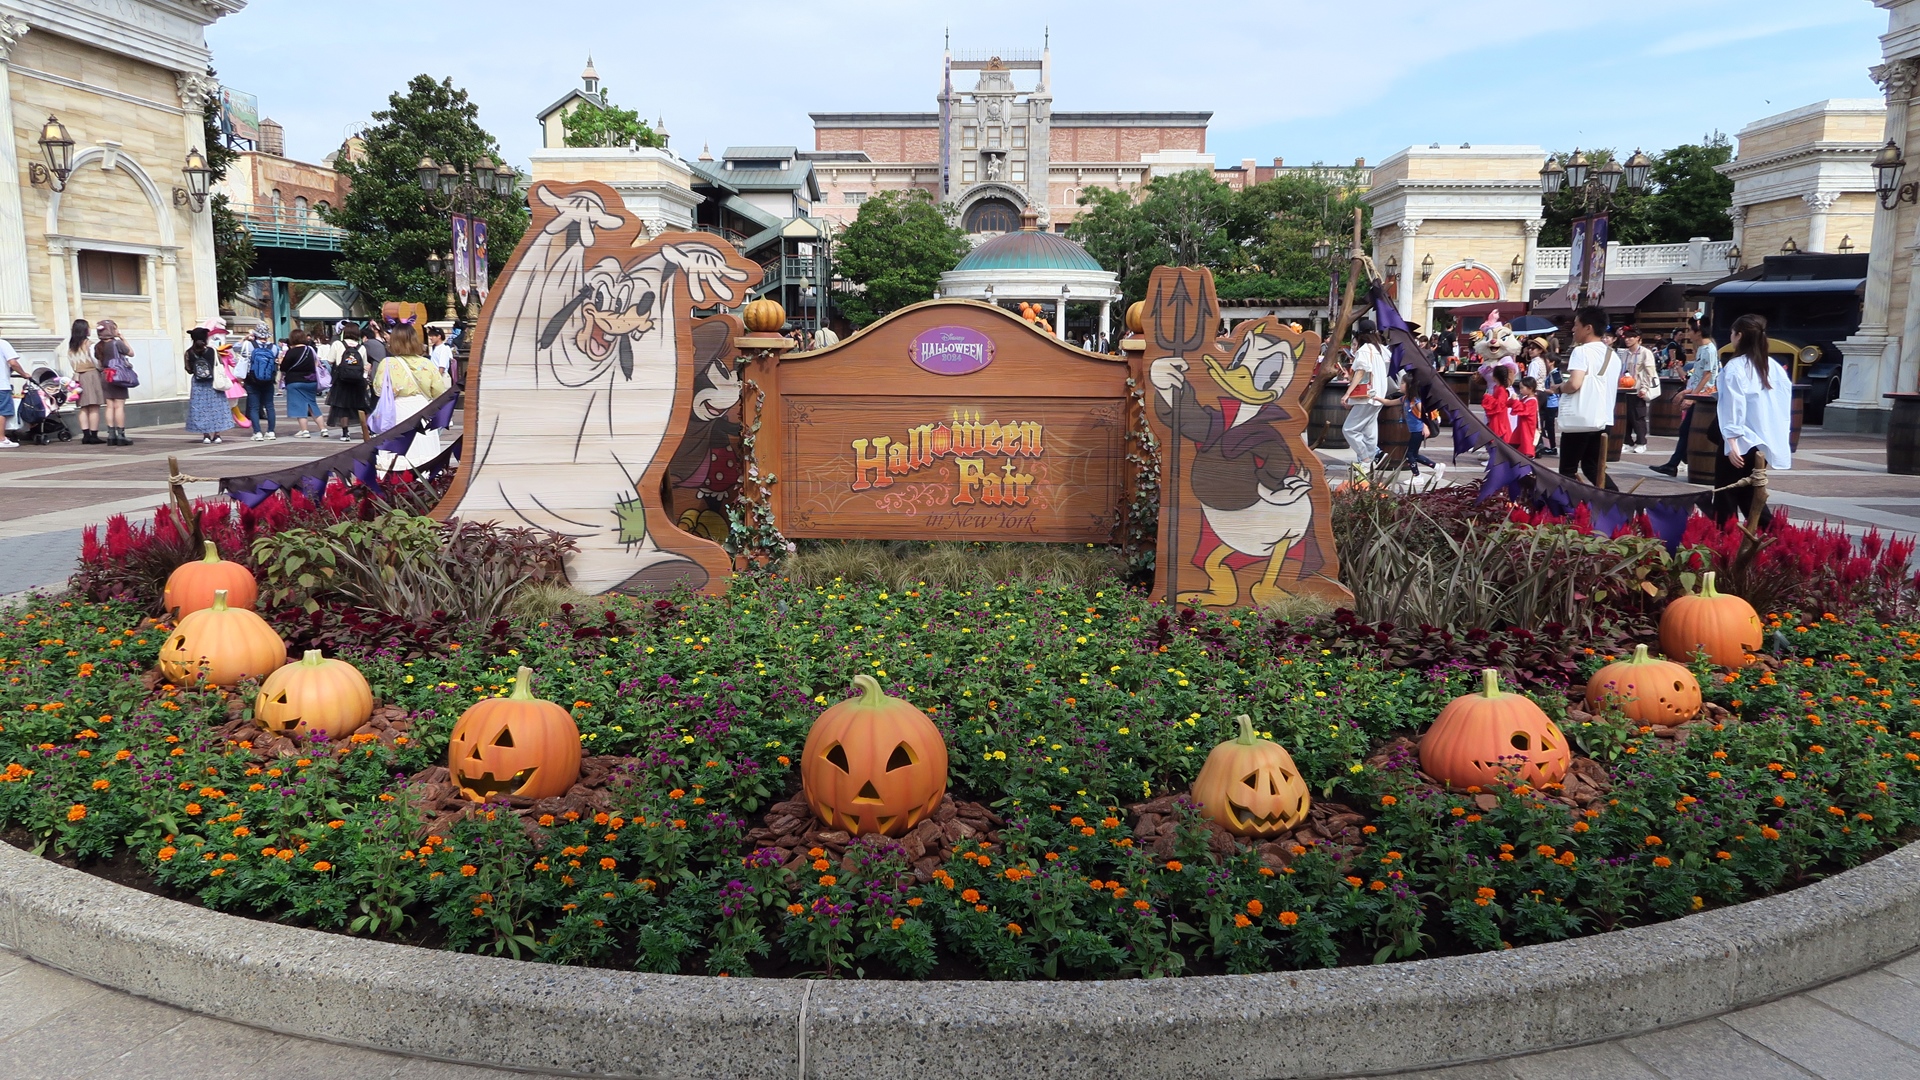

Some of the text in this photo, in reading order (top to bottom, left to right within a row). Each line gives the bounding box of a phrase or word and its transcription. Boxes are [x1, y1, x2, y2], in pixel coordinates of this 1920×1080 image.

[940, 332, 966, 342] Disney
[921, 342, 983, 364] HALLOWEEN
[941, 353, 962, 361] 2024
[851, 419, 1045, 492] Halloween
[952, 457, 1036, 507] Fair
[925, 508, 1039, 533] in New York
